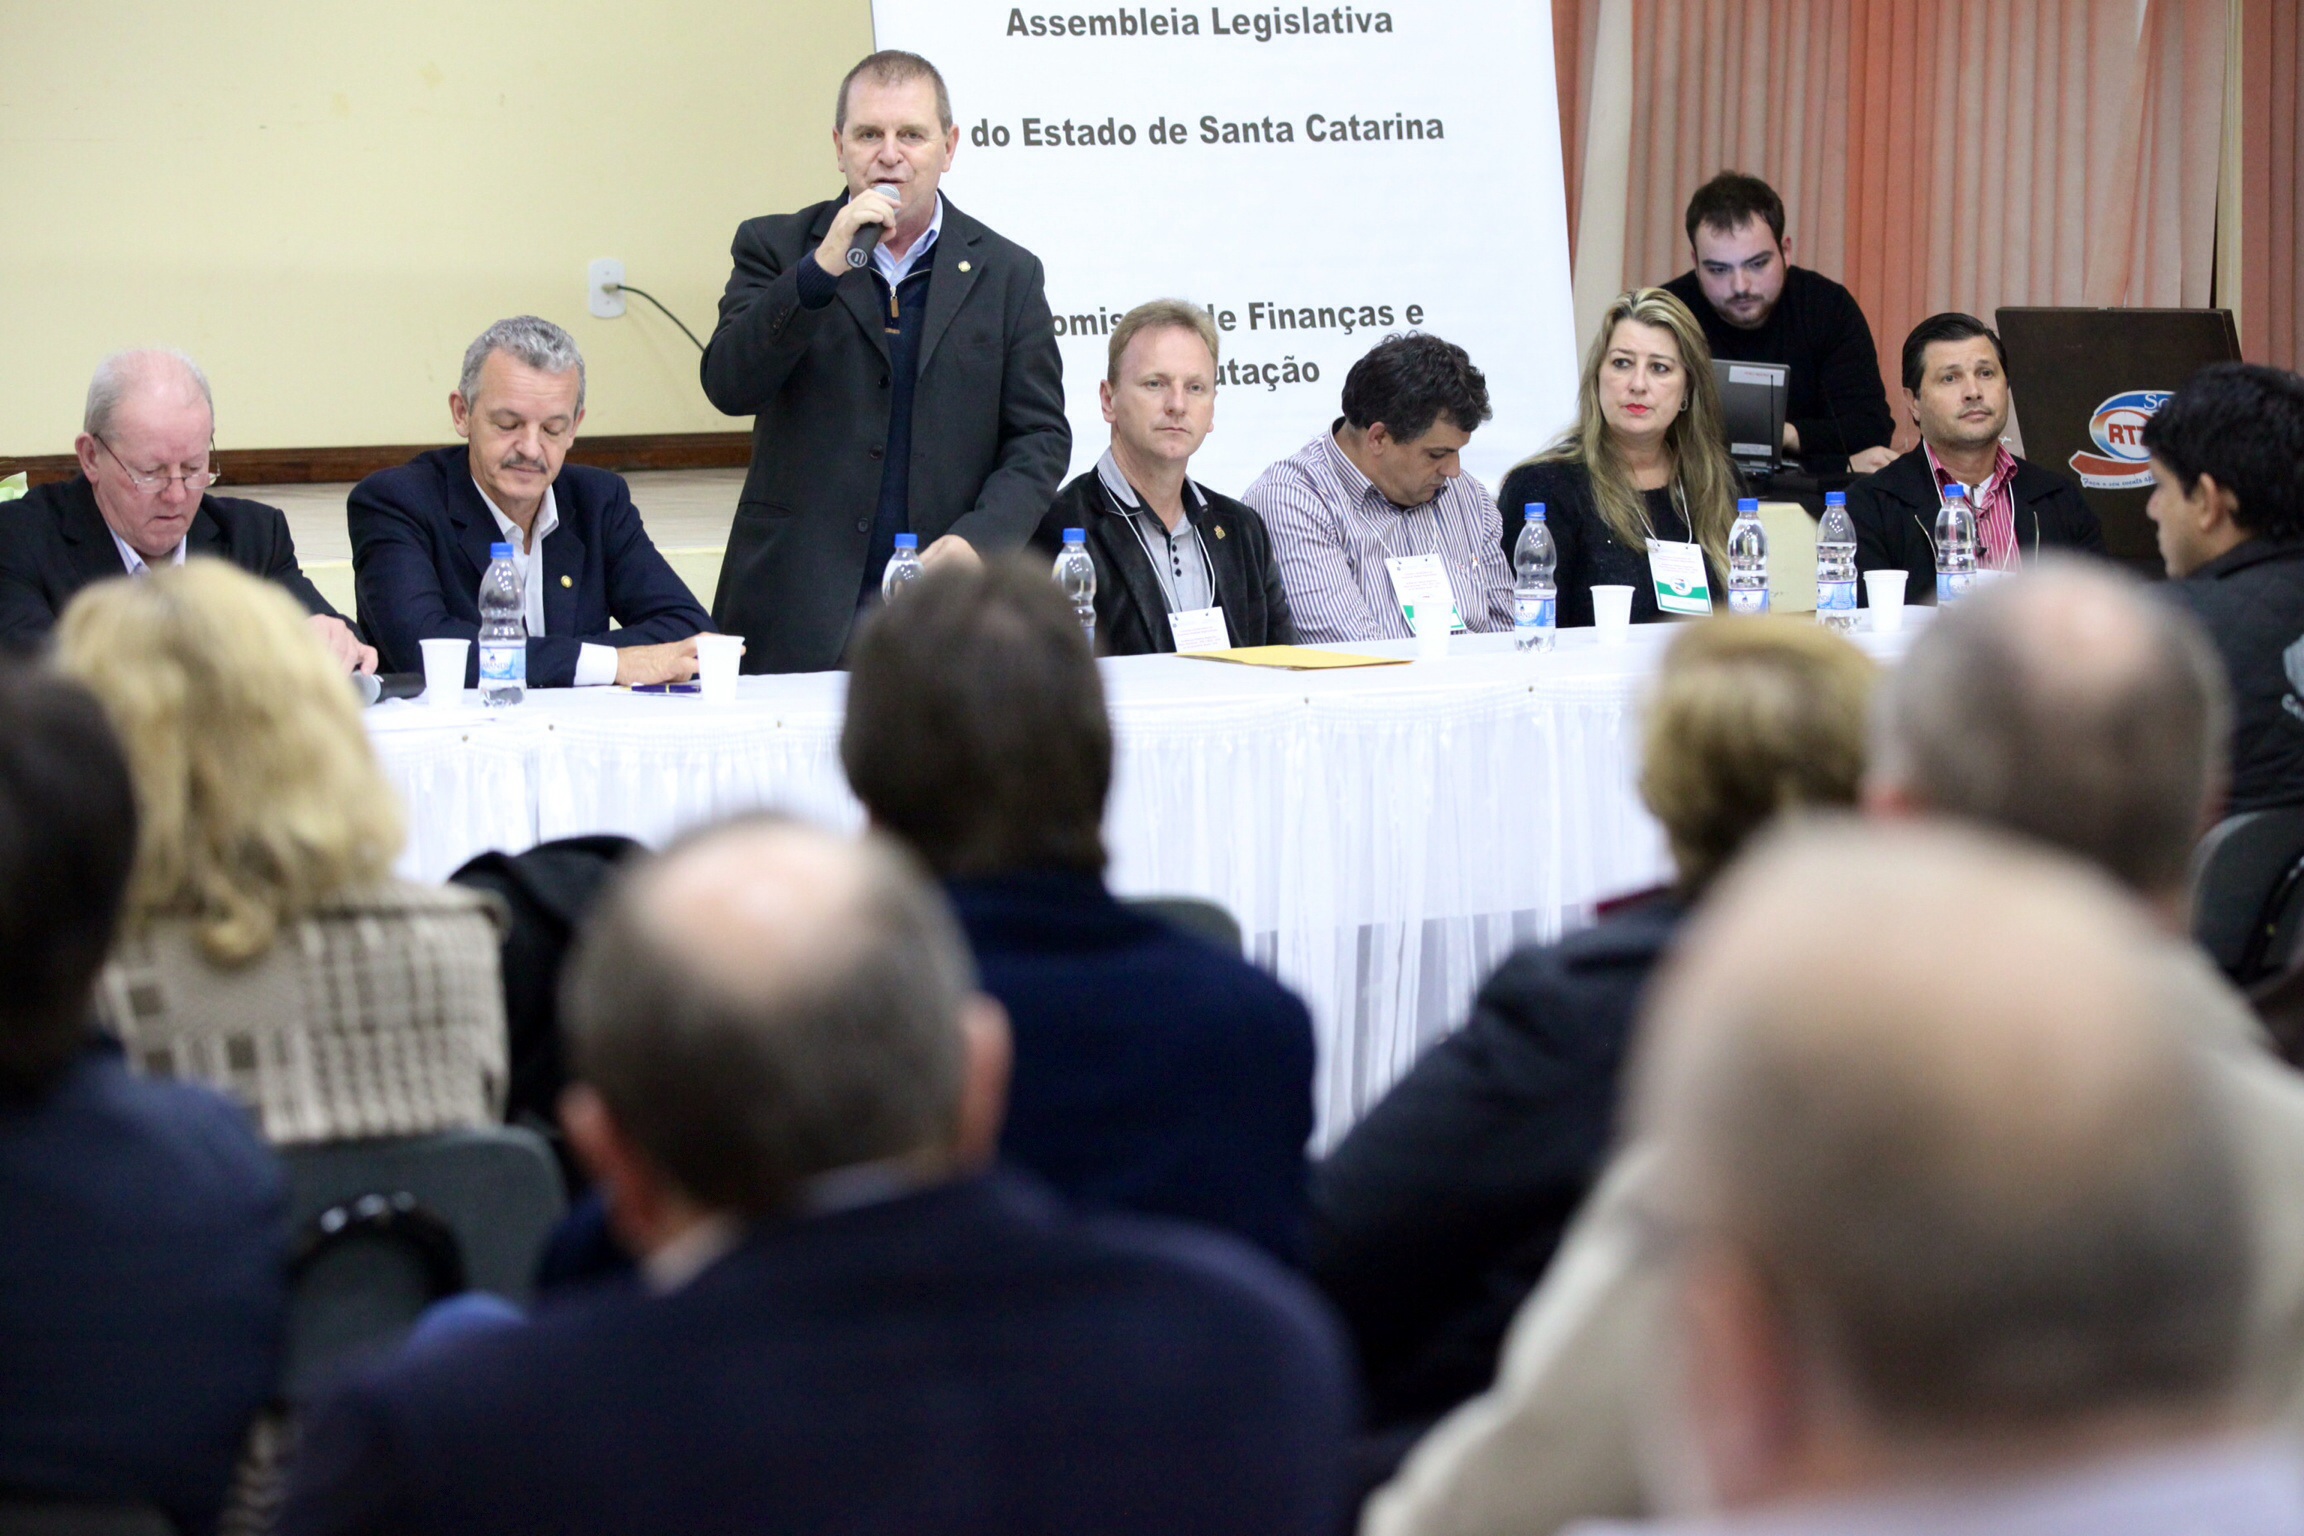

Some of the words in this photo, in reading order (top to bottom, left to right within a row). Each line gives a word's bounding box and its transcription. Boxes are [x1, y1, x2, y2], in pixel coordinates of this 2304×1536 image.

[1006, 7, 1200, 37] Assembleia
[1211, 6, 1393, 43] Legislativa
[971, 118, 1011, 148] do
[1022, 117, 1137, 147] Estado
[1148, 116, 1188, 145] de
[1199, 115, 1295, 144] Santa
[1305, 112, 1444, 143] Catarina
[1053, 306, 1123, 336] omis
[1248, 301, 1395, 336] Finanças
[1405, 304, 1424, 326] e
[1216, 355, 1320, 392] utação
[2108, 423, 2144, 446] RT
